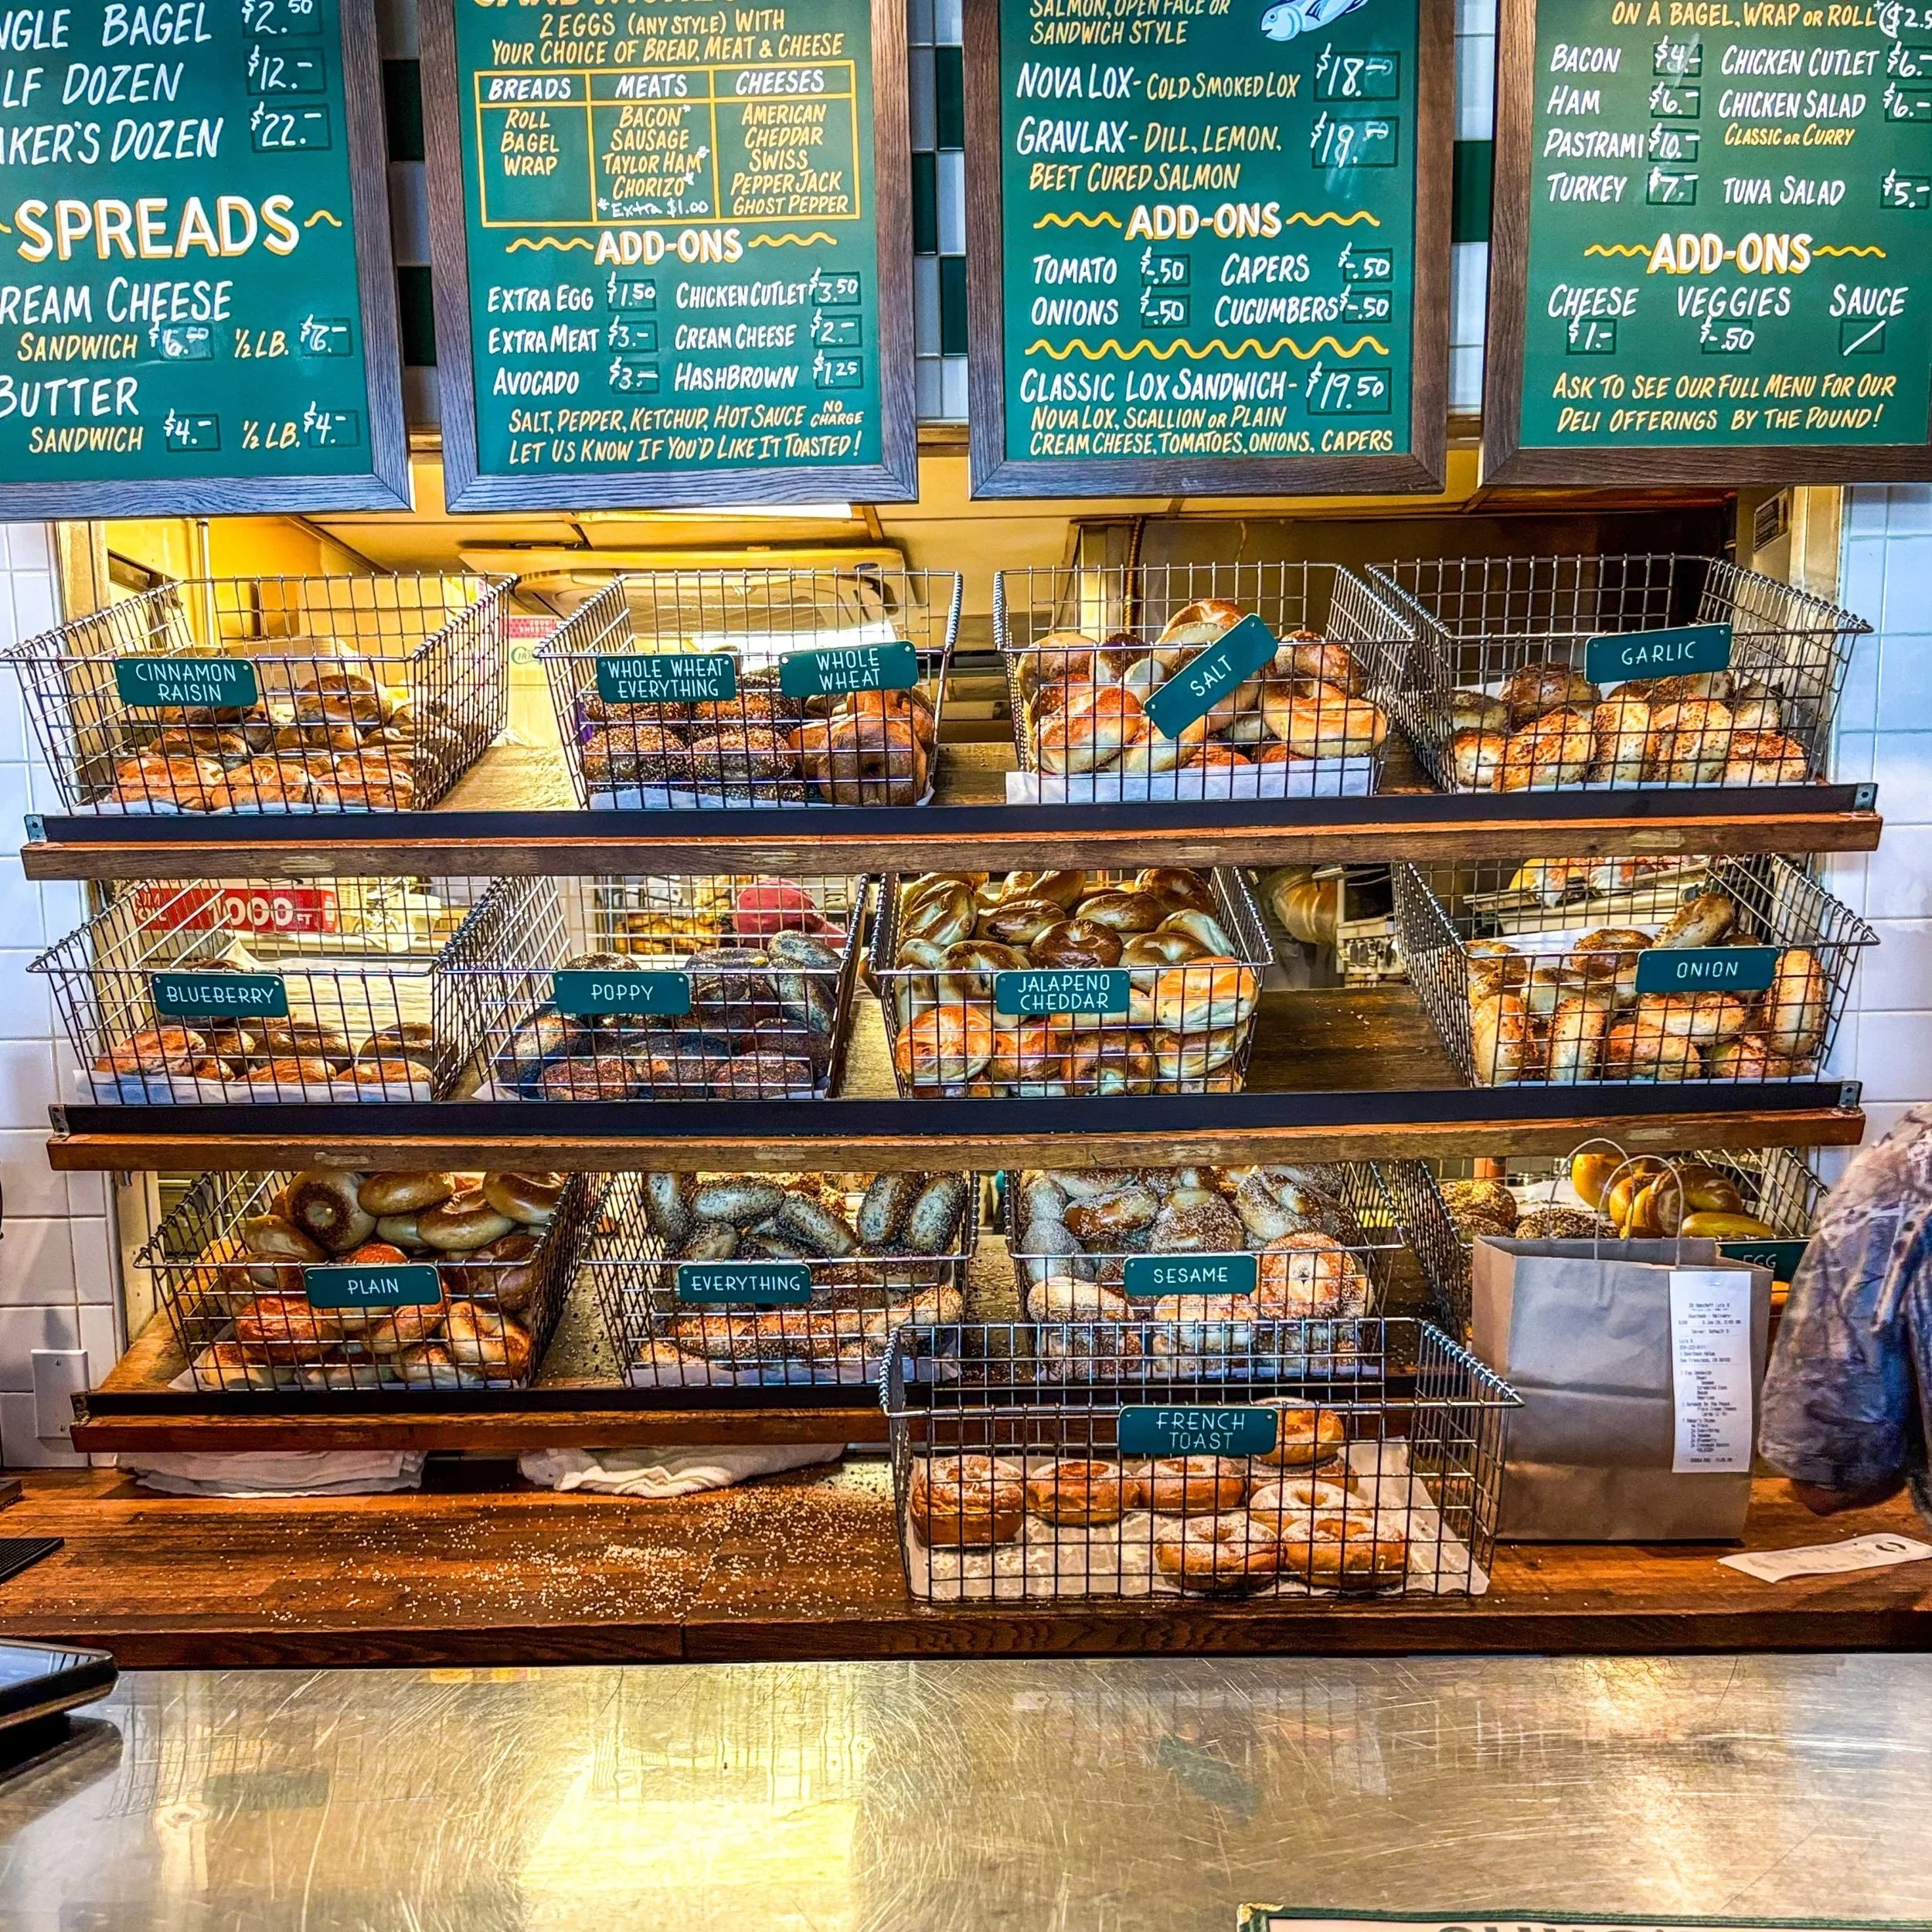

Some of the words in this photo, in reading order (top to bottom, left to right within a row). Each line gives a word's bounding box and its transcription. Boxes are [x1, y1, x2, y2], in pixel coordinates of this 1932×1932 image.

[1114, 0, 1160, 17] OPEN
[1611, 0, 1641, 26] ON
[1646, 0, 1662, 26] A
[1669, 2, 1741, 28] BAGEL,
[1743, 2, 1801, 27] WRAP
[1827, 2, 1879, 27] ROLL
[101, 2, 212, 47] BAGEL
[539, 12, 553, 39] 2
[558, 12, 616, 39] EGGS
[628, 12, 668, 36] (ANY
[670, 10, 727, 35] STYLE)
[735, 9, 784, 33] WITH
[1029, 20, 1125, 45] SANDWICH
[1128, 19, 1189, 45] STYLE
[492, 39, 535, 66] YOUR
[540, 39, 608, 65] CHOICE
[614, 39, 640, 64] OF
[642, 37, 700, 63] BREAD,
[703, 35, 757, 61] MEAT
[758, 39, 774, 59] &
[777, 32, 845, 59] CHEESE
[1549, 43, 1622, 73] BACON
[1721, 44, 1805, 76] CHICKEN
[1808, 47, 1880, 77] CUTLET
[62, 62, 185, 106] DOZEN
[488, 77, 571, 101] BREADS
[614, 73, 688, 99] MEATS
[735, 69, 825, 96] CHEESES
[1015, 62, 1083, 99] NOVA
[1146, 73, 1191, 100] COLD
[1192, 72, 1264, 99] SMOKED
[1266, 71, 1301, 99] LOX
[741, 102, 827, 126] AMERICAN
[1546, 84, 1601, 116] HAM
[1718, 89, 1801, 119] CHICKEN
[1803, 89, 1866, 119] SALAD
[505, 107, 551, 131] ROLL
[110, 117, 224, 163] DOZEN
[500, 131, 560, 154] BAGEL
[610, 128, 689, 151] SAUSAGE
[744, 125, 824, 149] CHEDDAR
[1144, 122, 1198, 155] DILL,
[1543, 128, 1645, 158] PASTRAMI
[1724, 122, 1783, 146] CLASSIC
[1802, 122, 1855, 147] CURRY
[504, 154, 558, 177] WRAP
[601, 152, 661, 175] TAYLOR
[749, 148, 808, 173] SWISS
[730, 172, 795, 196] PEPPER
[794, 168, 842, 193] JACK
[1029, 162, 1083, 192] BEET
[1087, 162, 1153, 192] CURED
[1153, 162, 1241, 192] SALMON
[1546, 172, 1628, 202] TURKEY
[1723, 177, 1772, 205] TUNA
[1779, 175, 1846, 206] SALAD
[733, 196, 787, 216] GHOST
[787, 194, 849, 214] PEPPER
[14, 194, 300, 263] SPREADS
[1124, 201, 1282, 241] ADD-ONS
[594, 227, 743, 265] ADD-ONS
[1645, 232, 1813, 274] ADD-ONS
[1032, 253, 1117, 285] TOMATO
[1220, 253, 1310, 287] CAPERS
[106, 276, 233, 324] CHEESE
[487, 286, 552, 314] EXTRA
[556, 284, 594, 311] EGG
[675, 281, 750, 309] CHICKEN
[750, 280, 808, 308] CUTLET
[1547, 284, 1640, 319] CHEESE
[1678, 286, 1791, 318] VEGGIES
[1828, 283, 1909, 317] SAUCE
[1031, 296, 1119, 326] ONIONS
[1214, 294, 1339, 328] CUCUMBERS
[17, 332, 138, 362] SANDWICH
[488, 327, 548, 355] EXTRA
[549, 324, 600, 353] MEAT
[675, 324, 733, 351] CREAM
[735, 323, 798, 350] CHEESE
[492, 366, 580, 396] AVOCADO
[1019, 368, 1115, 403] CLASSIC
[1125, 370, 1171, 403] LOX
[1552, 372, 1597, 400] ASK
[1600, 373, 1625, 400] TO
[1631, 374, 1672, 400] SEE
[1675, 375, 1716, 399] OUR
[1718, 374, 1760, 399] FULL
[1763, 373, 1818, 399] MENU
[1821, 372, 1855, 398] FOR
[1856, 372, 1897, 398] OUR
[0, 374, 139, 419] BUTTER
[822, 400, 843, 413] NO
[508, 408, 554, 435] SALT,
[557, 408, 628, 434] PEPPER,
[629, 406, 709, 431] KETCHUP,
[713, 404, 754, 429] HOT
[750, 403, 808, 429] SAUCE
[809, 410, 864, 428] CHARGE
[1030, 404, 1079, 431] NOVA
[1081, 404, 1120, 431] LOX,
[1123, 406, 1207, 430] SCALLION
[1230, 404, 1287, 428] PLAIN
[1556, 406, 1601, 433] DELI
[1609, 409, 1718, 433] OFFERINGS
[1730, 409, 1759, 430] BY
[1764, 408, 1803, 429] THE
[1804, 403, 1884, 430] POUND!
[29, 426, 144, 454] SANDWICH
[509, 440, 547, 465] LET
[551, 439, 576, 463] US
[580, 438, 634, 462] KNOW
[636, 437, 665, 462] IF
[668, 436, 715, 461] YOU'D
[716, 434, 759, 460] LIKE
[757, 434, 783, 460] IT
[784, 430, 862, 458] TOASTED!
[1029, 430, 1090, 456] CREAM
[1092, 431, 1158, 455] CHEESE,
[1158, 430, 1248, 455] TOMATOES,
[1321, 429, 1393, 453] CAPERS
[815, 648, 880, 673] WHOLE
[1621, 641, 1696, 665] GARLIC
[135, 663, 236, 682] CINNAMON
[607, 659, 662, 679] WHOLE
[670, 658, 723, 678] WHEAT
[818, 668, 880, 691] WHEAT
[1190, 655, 1233, 695] SALT
[158, 683, 222, 702] RAISIN
[617, 679, 719, 699] EVERYTHING
[1676, 961, 1738, 978] ONION
[166, 986, 274, 1004] BLUEBERRY
[590, 984, 653, 1001] POPPY
[1018, 974, 1110, 995] JALAPENO
[1020, 992, 1108, 1011] CHEDDAR
[347, 1278, 399, 1294] PLAIN
[691, 1276, 801, 1291] EVERYTHING
[1154, 1267, 1228, 1284] SESAME
[1156, 1412, 1244, 1430] FRENCH
[1169, 1432, 1233, 1450] TOAST
